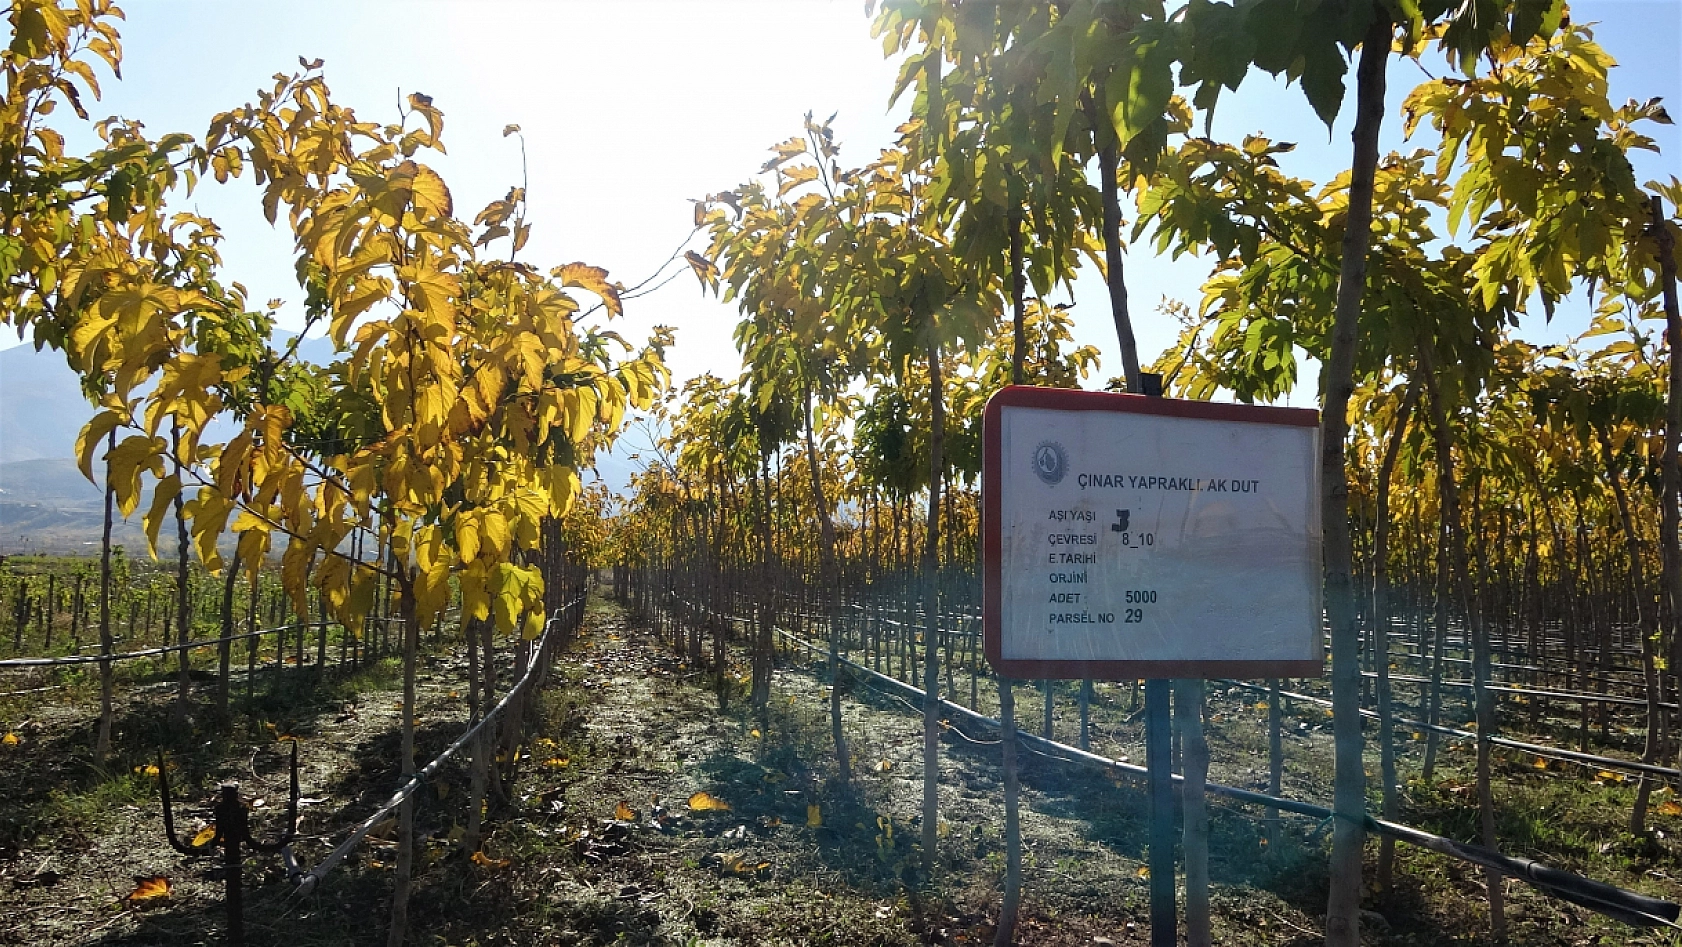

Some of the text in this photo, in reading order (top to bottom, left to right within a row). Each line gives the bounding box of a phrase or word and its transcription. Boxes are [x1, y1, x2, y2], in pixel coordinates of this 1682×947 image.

[1078, 473, 1124, 490] ÇINAR
[1207, 479, 1227, 492] AK
[1231, 480, 1259, 493] DUT
[1048, 590, 1157, 604] ADET 5000
[1049, 608, 1143, 624] PARSEL NO 29
